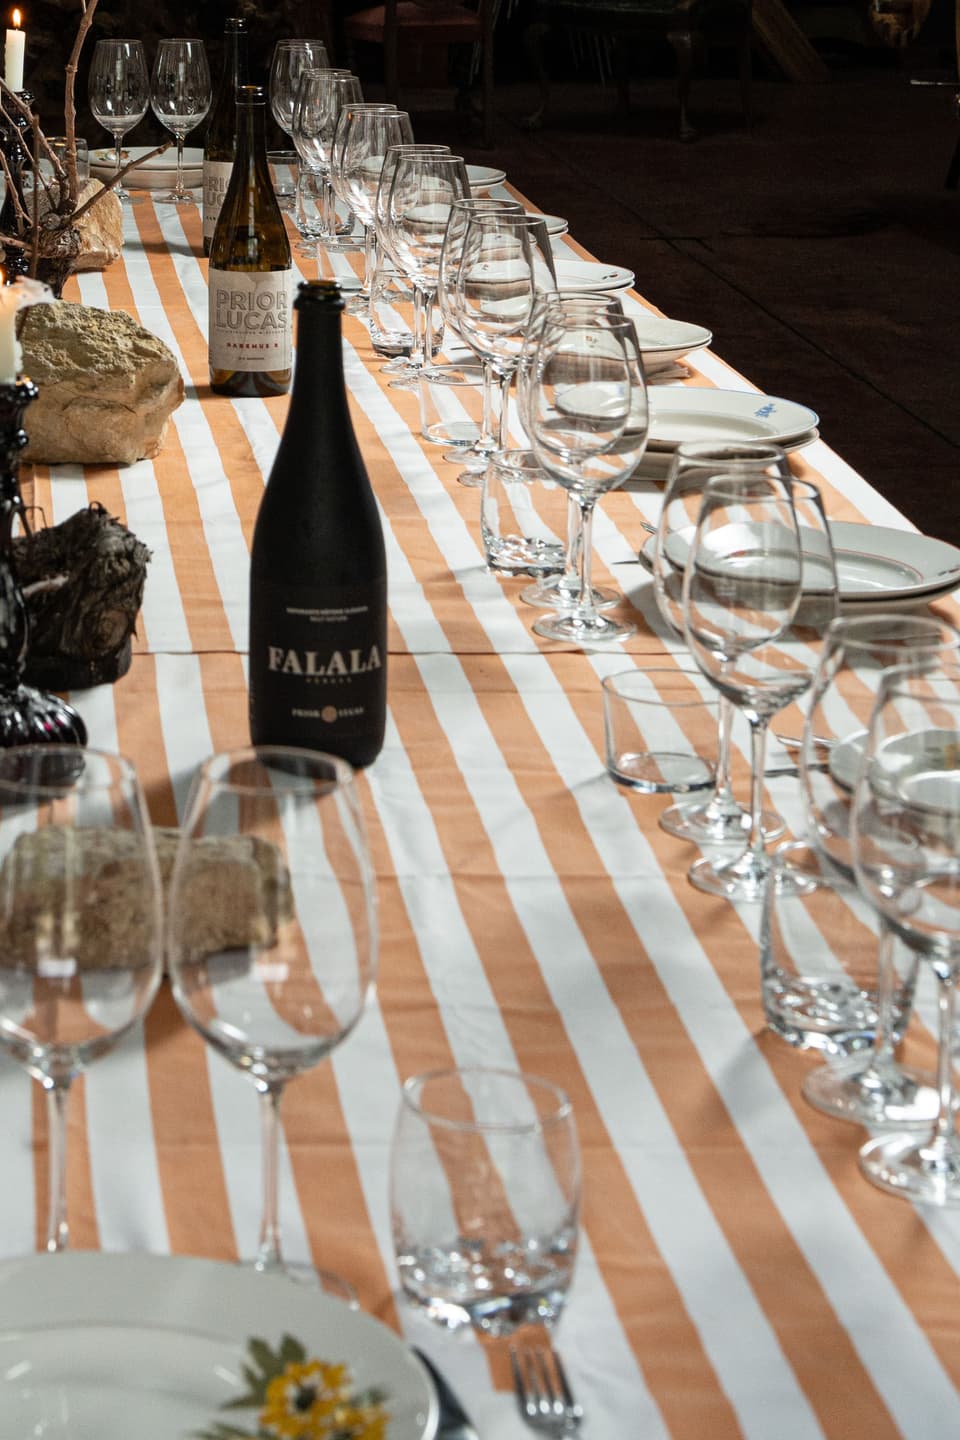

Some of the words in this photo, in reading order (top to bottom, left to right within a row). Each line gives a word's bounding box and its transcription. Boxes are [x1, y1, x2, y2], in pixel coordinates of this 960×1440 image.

[216, 289, 288, 311] PRIOR
[216, 310, 287, 330] LUCAS
[268, 645, 382, 676] FALALA
